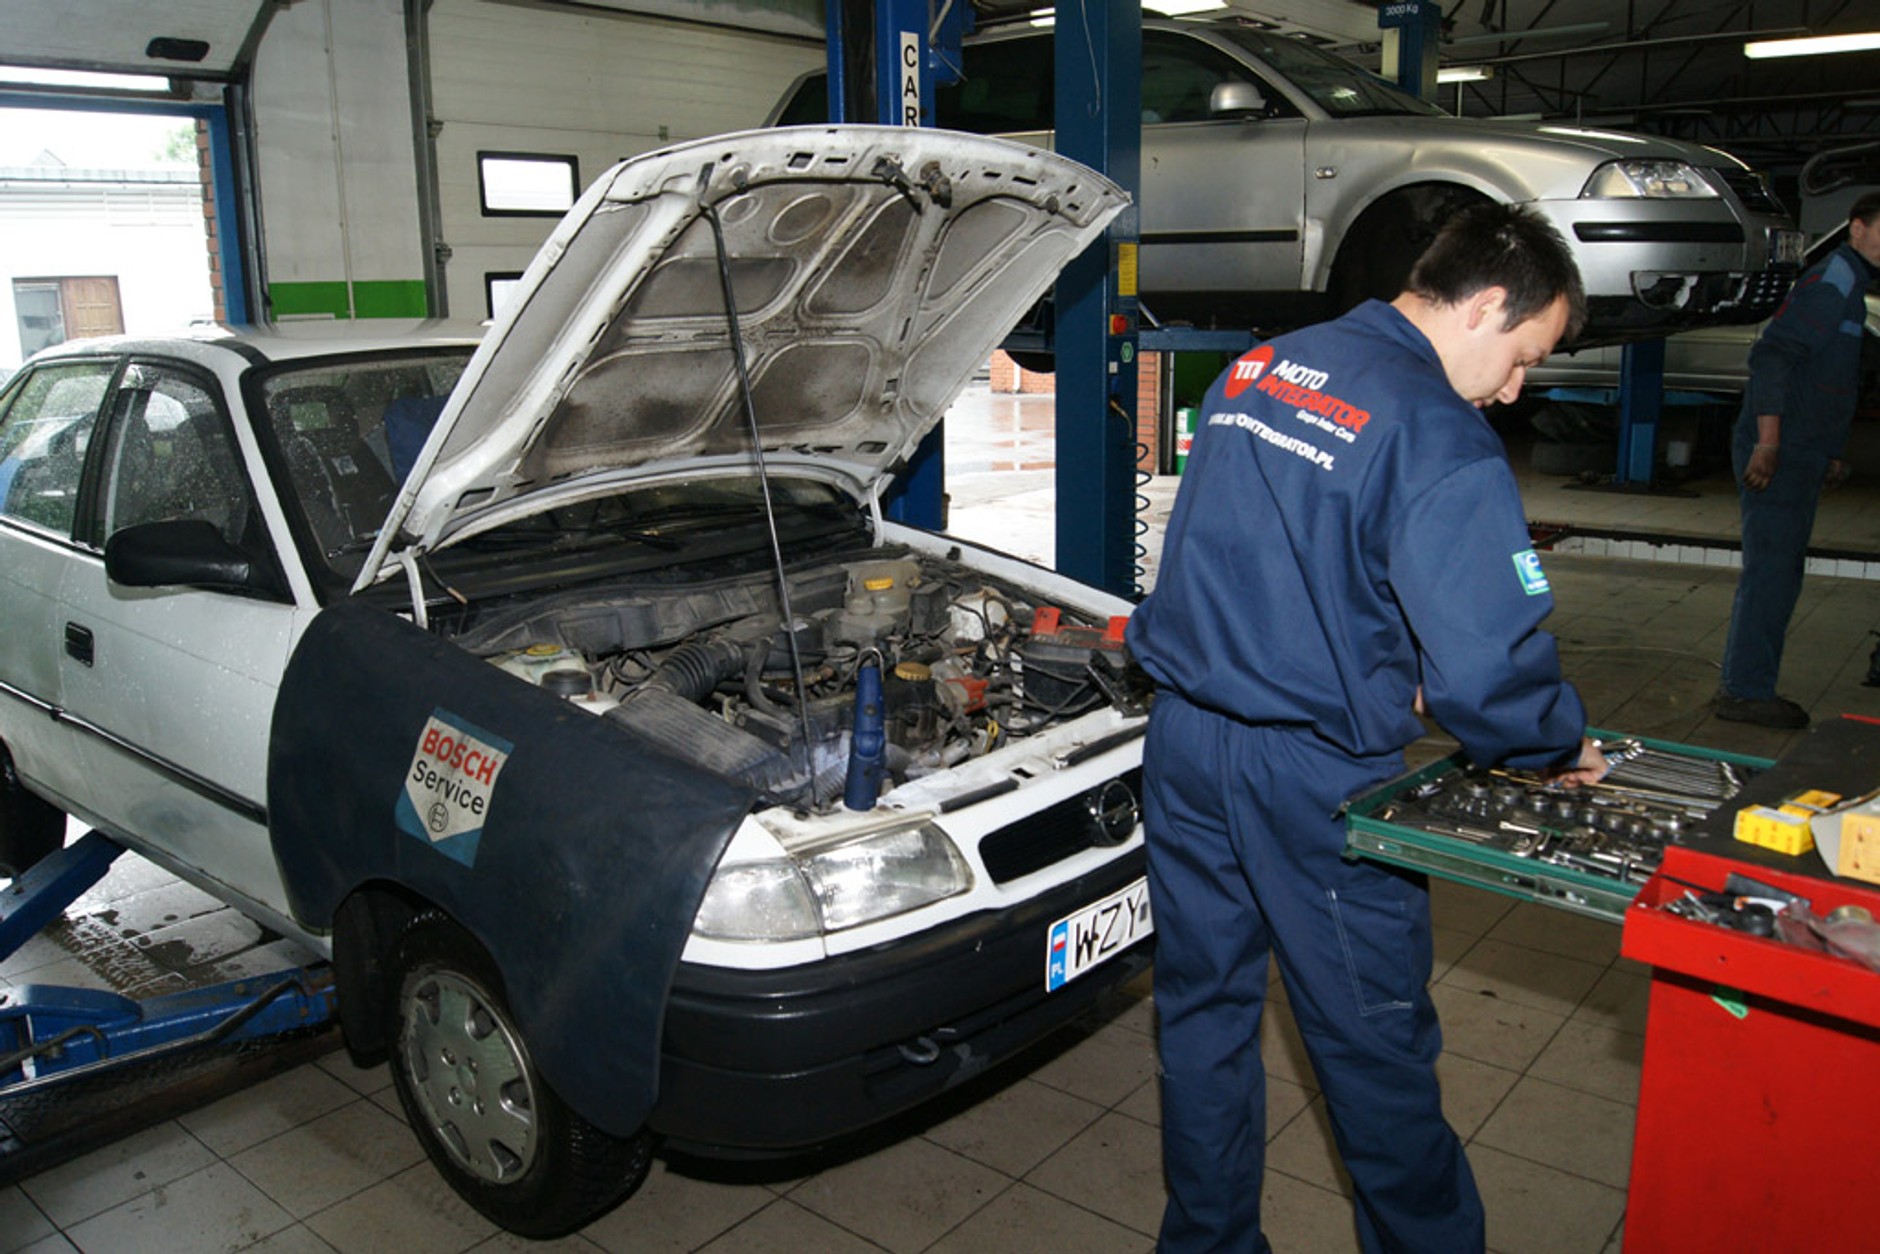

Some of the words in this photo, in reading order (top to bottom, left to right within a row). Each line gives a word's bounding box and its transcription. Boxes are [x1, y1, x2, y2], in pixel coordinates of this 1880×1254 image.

[903, 44, 918, 127] CAR
[1256, 374, 1371, 433] INTEGRATOR
[1271, 359, 1329, 390] MOTO
[422, 727, 498, 786] BOSCH
[413, 760, 485, 815] Service
[1075, 888, 1144, 969] WZY
[1051, 961, 1065, 978] PL
